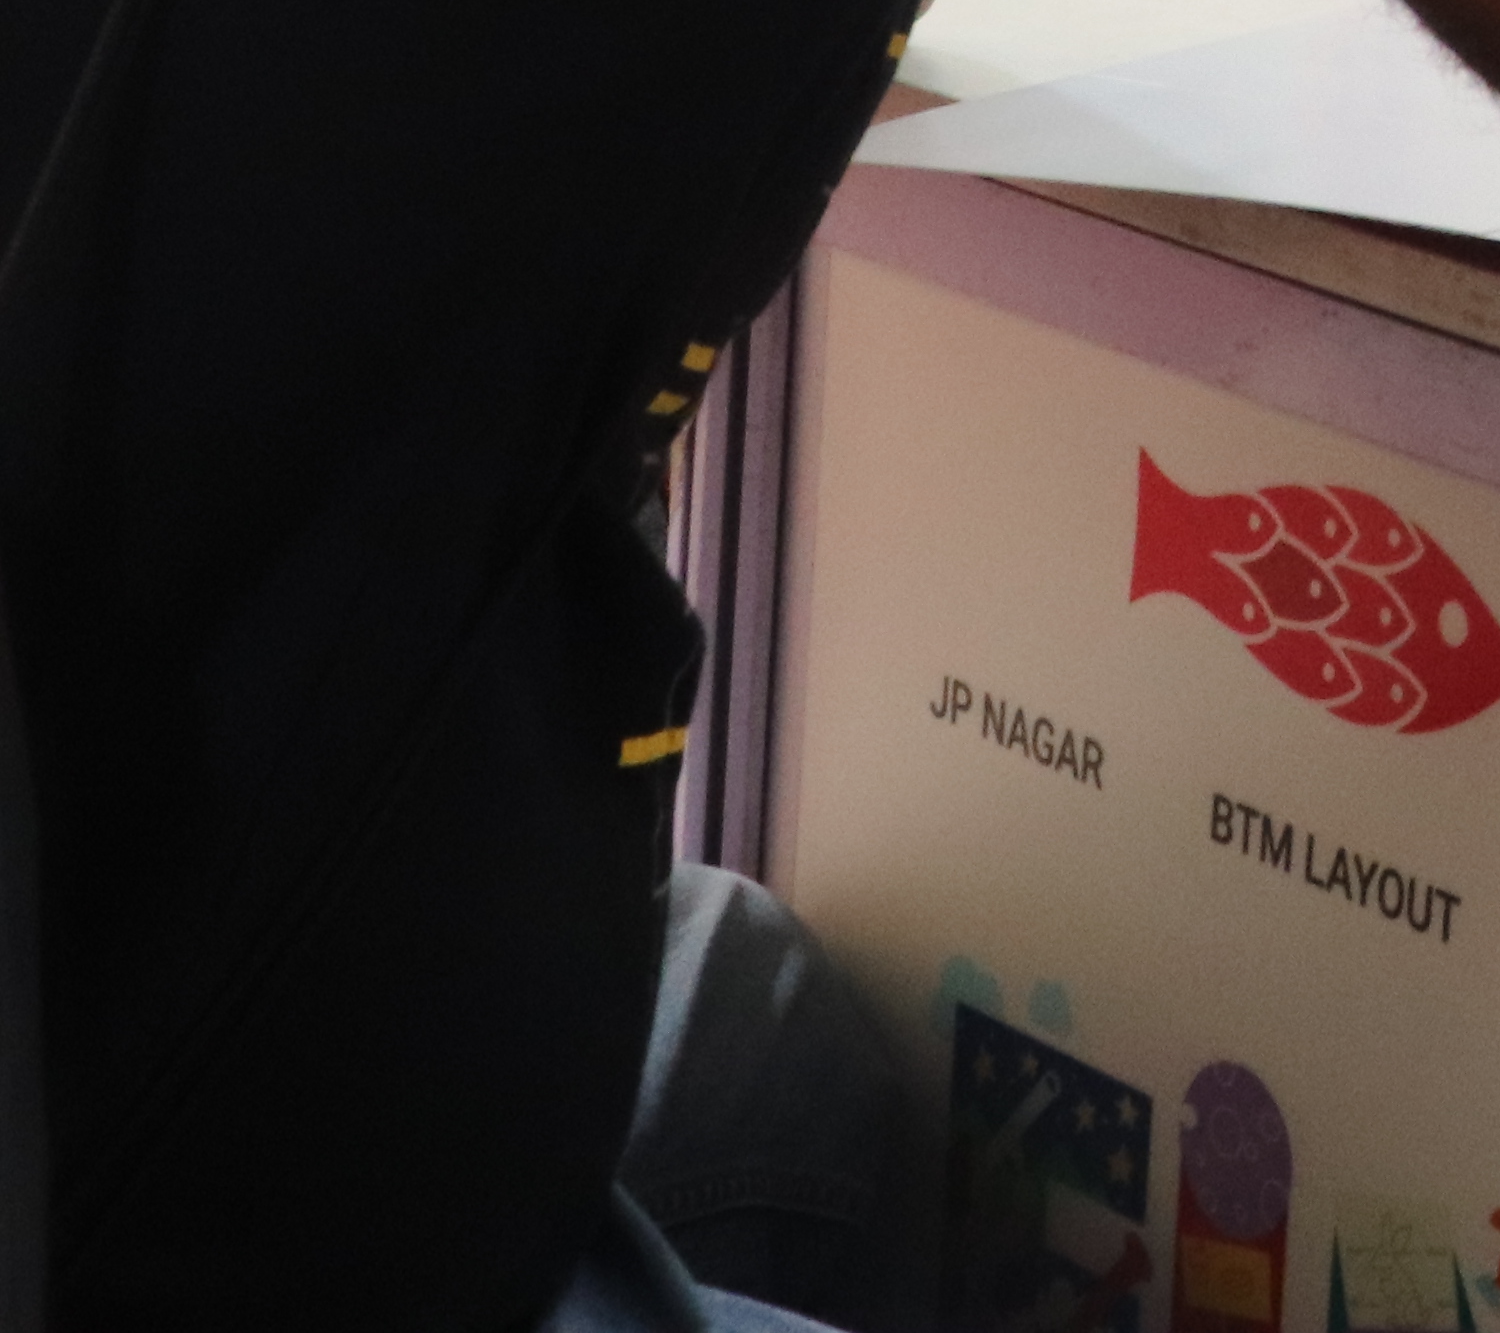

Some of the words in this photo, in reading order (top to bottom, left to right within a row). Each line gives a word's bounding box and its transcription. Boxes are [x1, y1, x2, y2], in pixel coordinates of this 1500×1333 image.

[931, 676, 973, 724] JP
[983, 693, 1104, 791] NAGAR
[1211, 794, 1293, 872] BTM
[1305, 834, 1461, 943] LAYOUT
